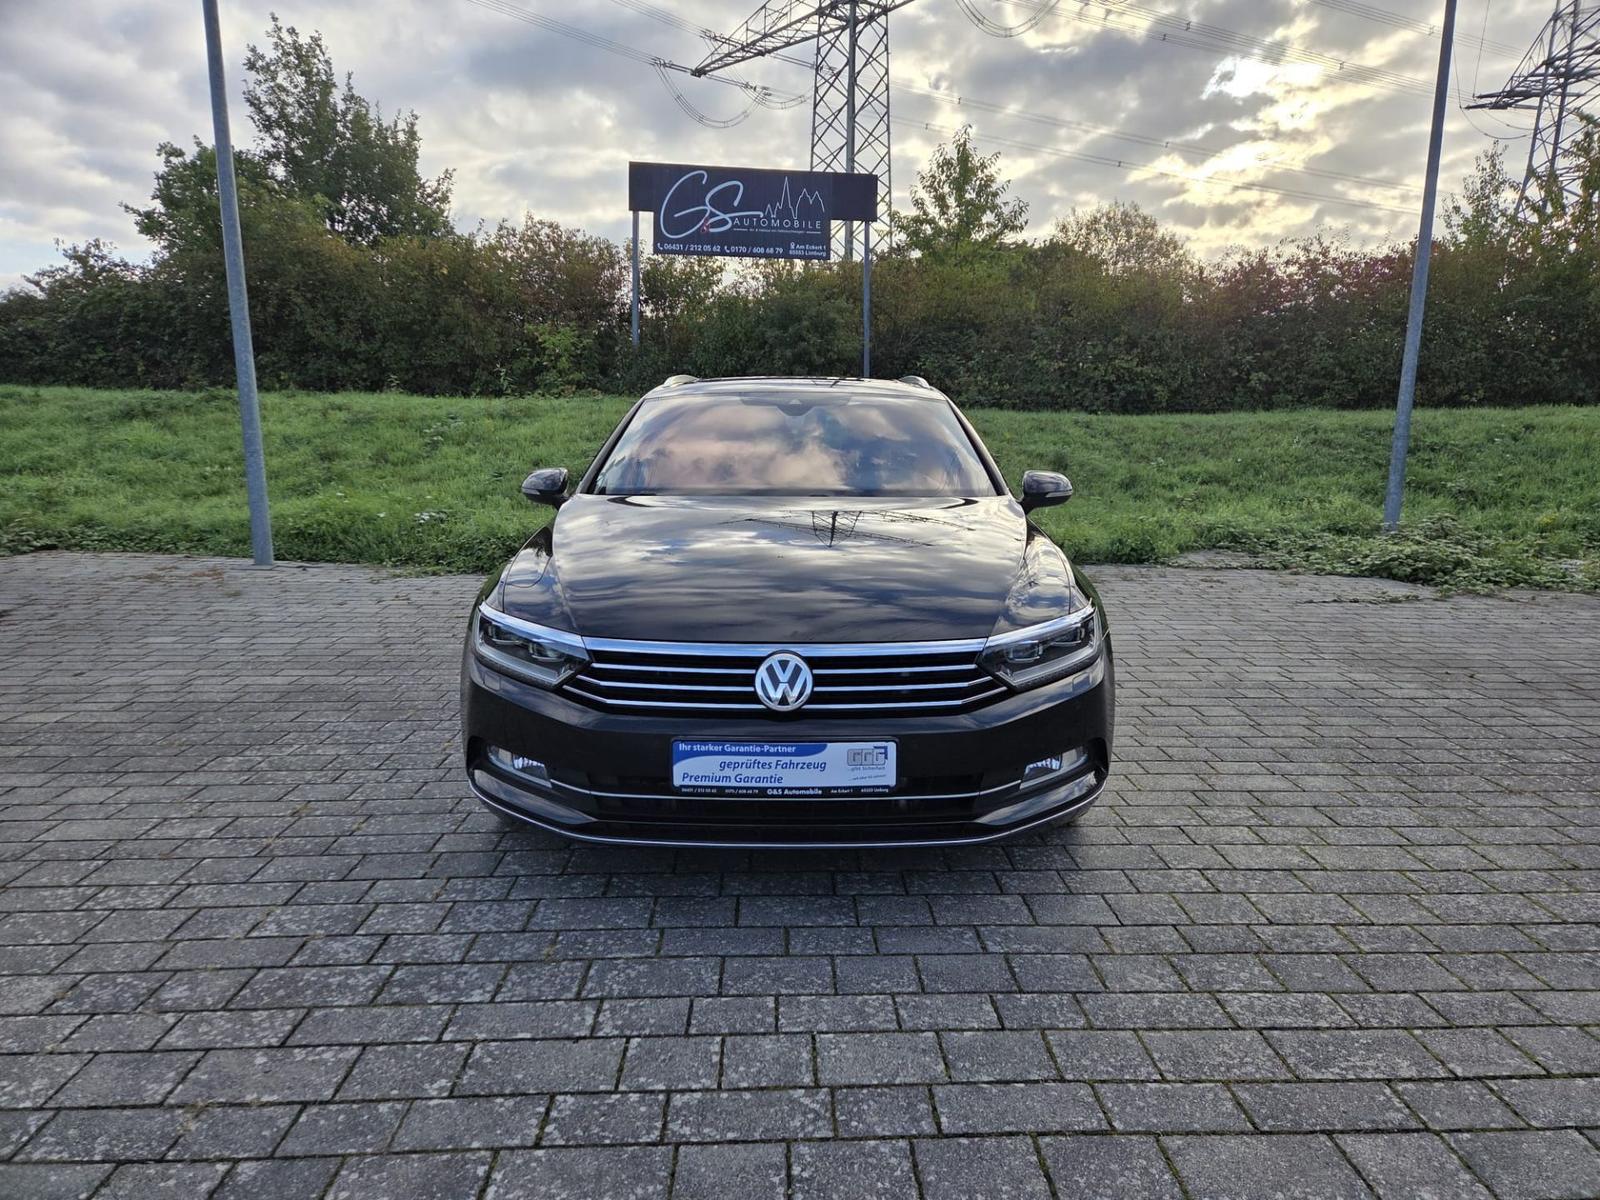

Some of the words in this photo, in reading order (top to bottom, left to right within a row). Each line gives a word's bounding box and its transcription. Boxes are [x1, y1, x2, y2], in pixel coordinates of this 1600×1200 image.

[733, 217, 821, 229] AUTOMOBILE
[663, 243, 683, 251] 06431
[689, 244, 701, 252] 212
[755, 653, 813, 712] VW
[679, 743, 692, 751] Ihr
[693, 743, 722, 752] starker
[724, 744, 797, 753] Garantie-Partner
[719, 759, 773, 771] geprüftes
[774, 760, 827, 772] Fahrzeug
[682, 772, 731, 783] Premium
[734, 773, 784, 784] Garantie
